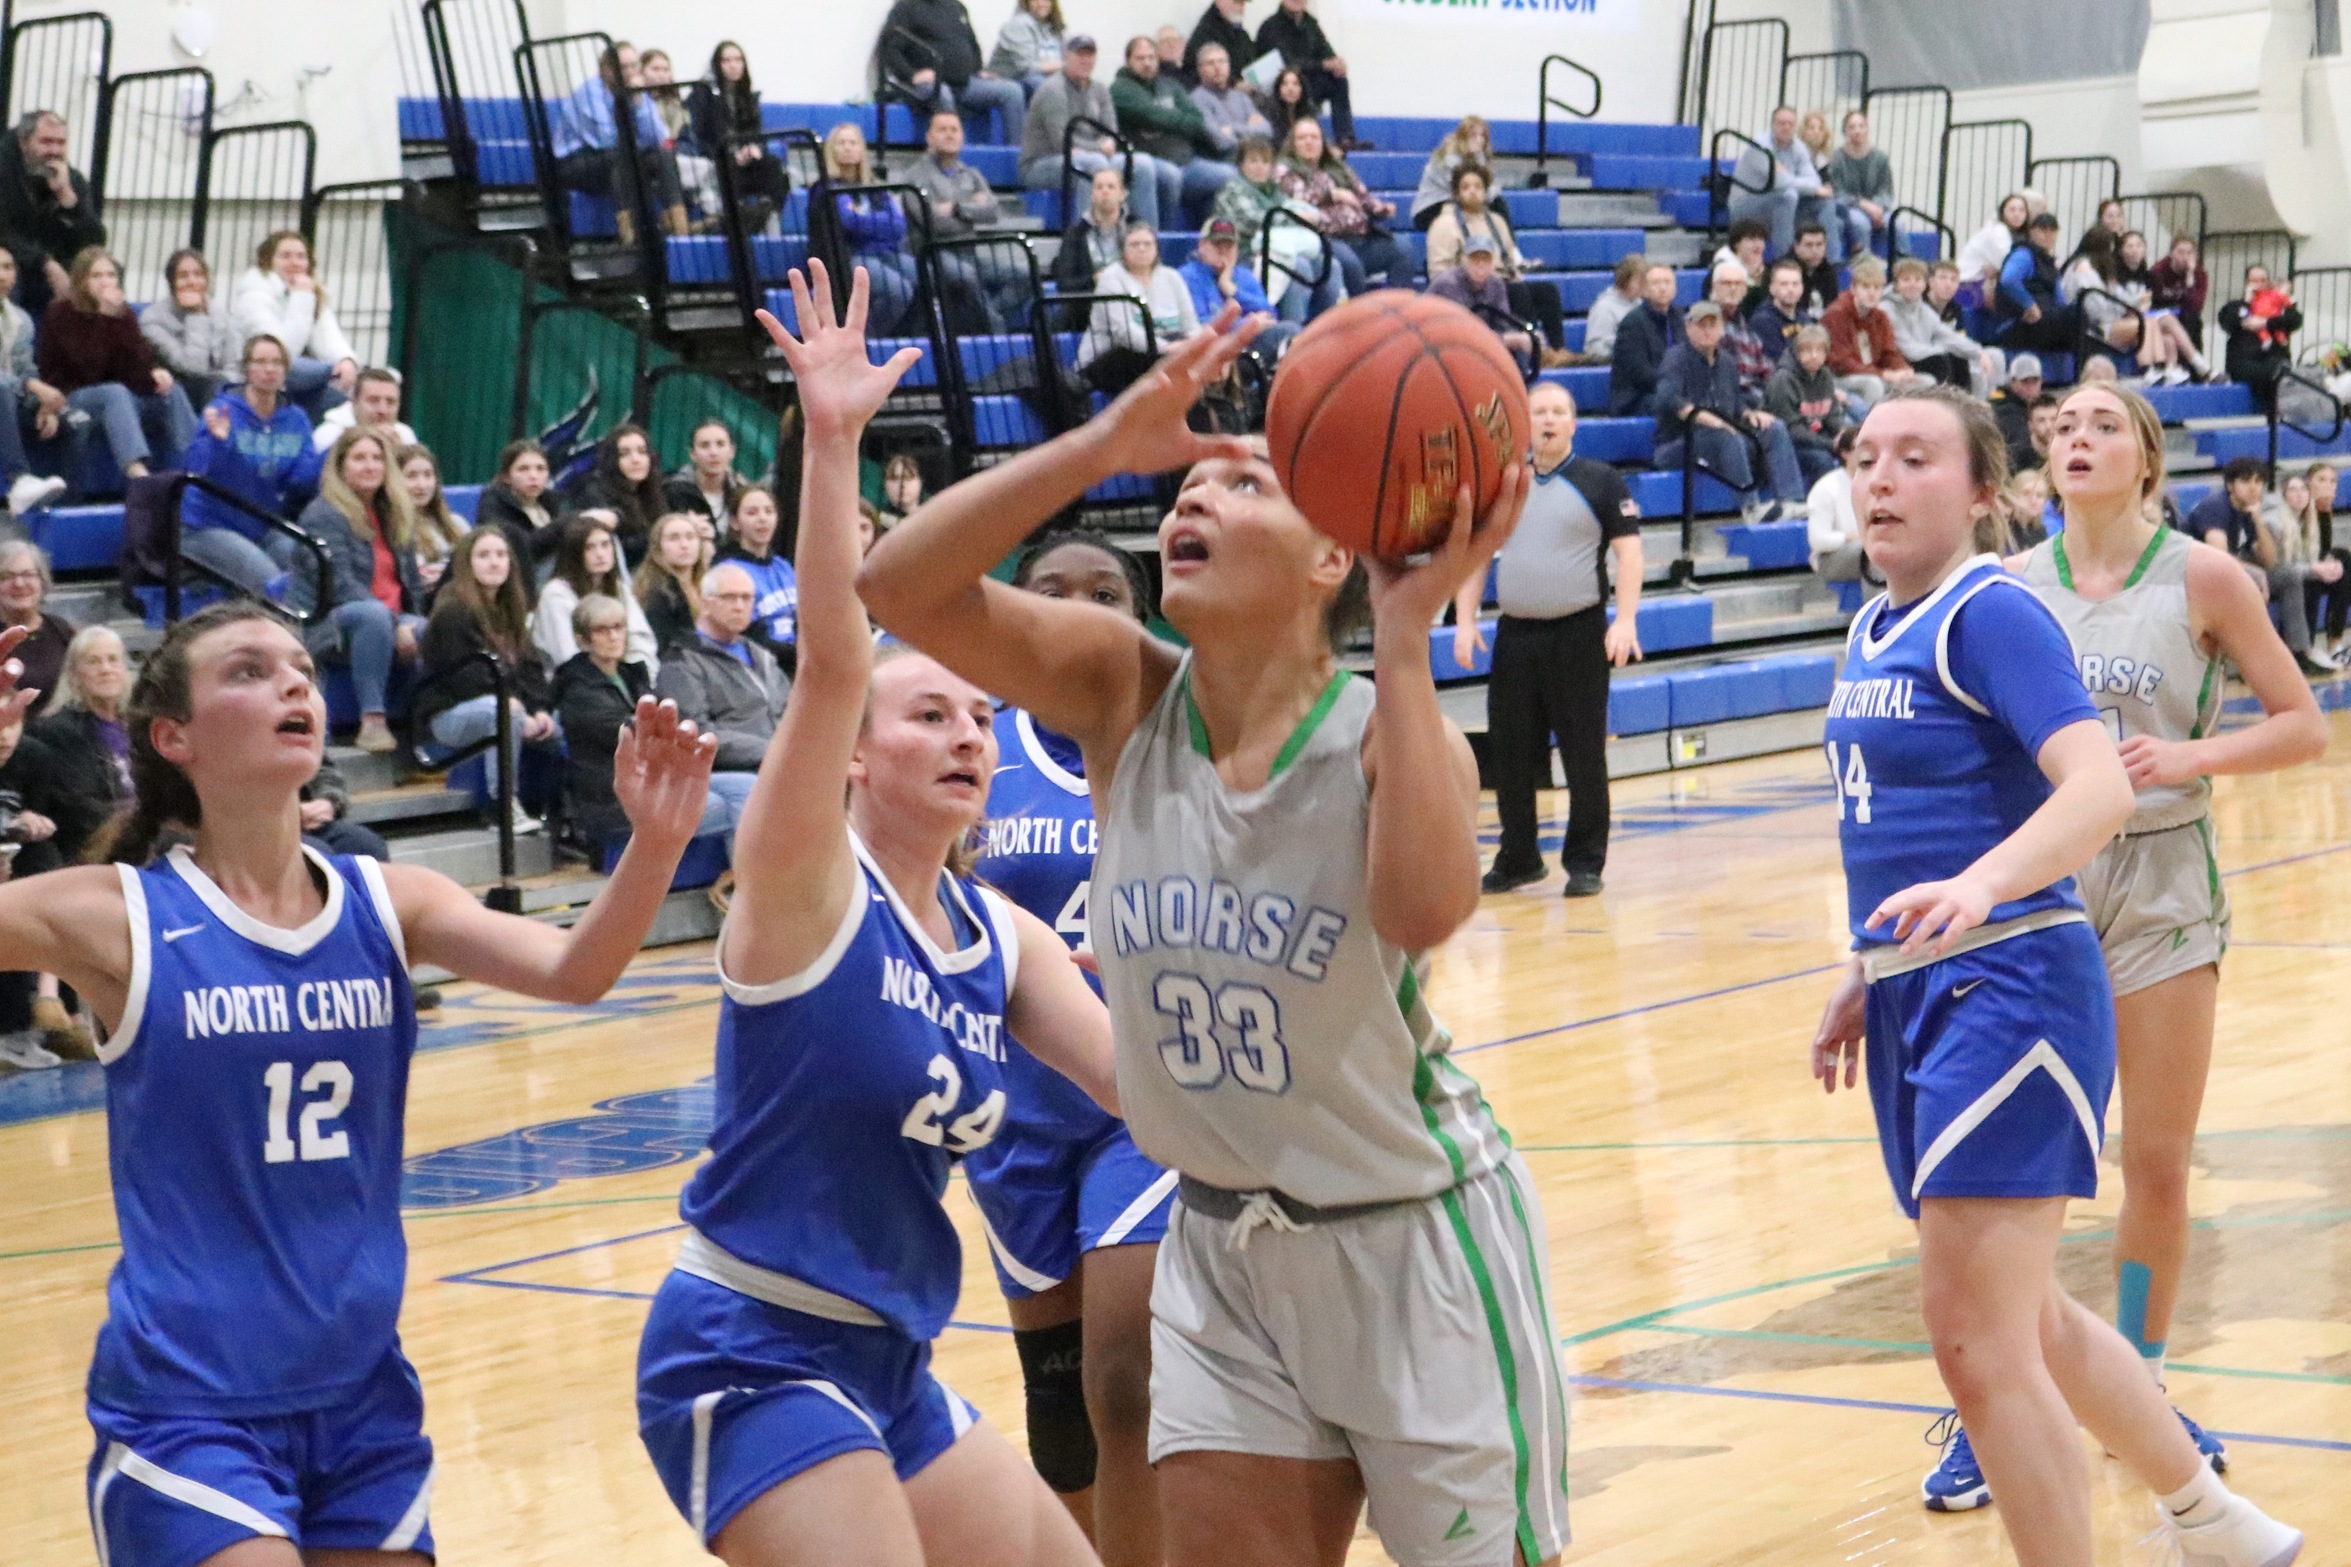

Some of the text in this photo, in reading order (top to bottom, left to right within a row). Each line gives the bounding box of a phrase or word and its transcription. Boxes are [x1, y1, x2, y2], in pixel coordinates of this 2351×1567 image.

[1845, 678, 1916, 719] CENTRAL
[2081, 653, 2164, 706] RSE
[1828, 740, 1873, 824] 14
[987, 817, 1063, 858] NORTH
[1111, 873, 1347, 983] NORSE
[183, 984, 291, 1039] NORTH
[1152, 968, 1292, 1097] 33
[263, 1060, 355, 1164] 12
[900, 1053, 1007, 1155] 24
